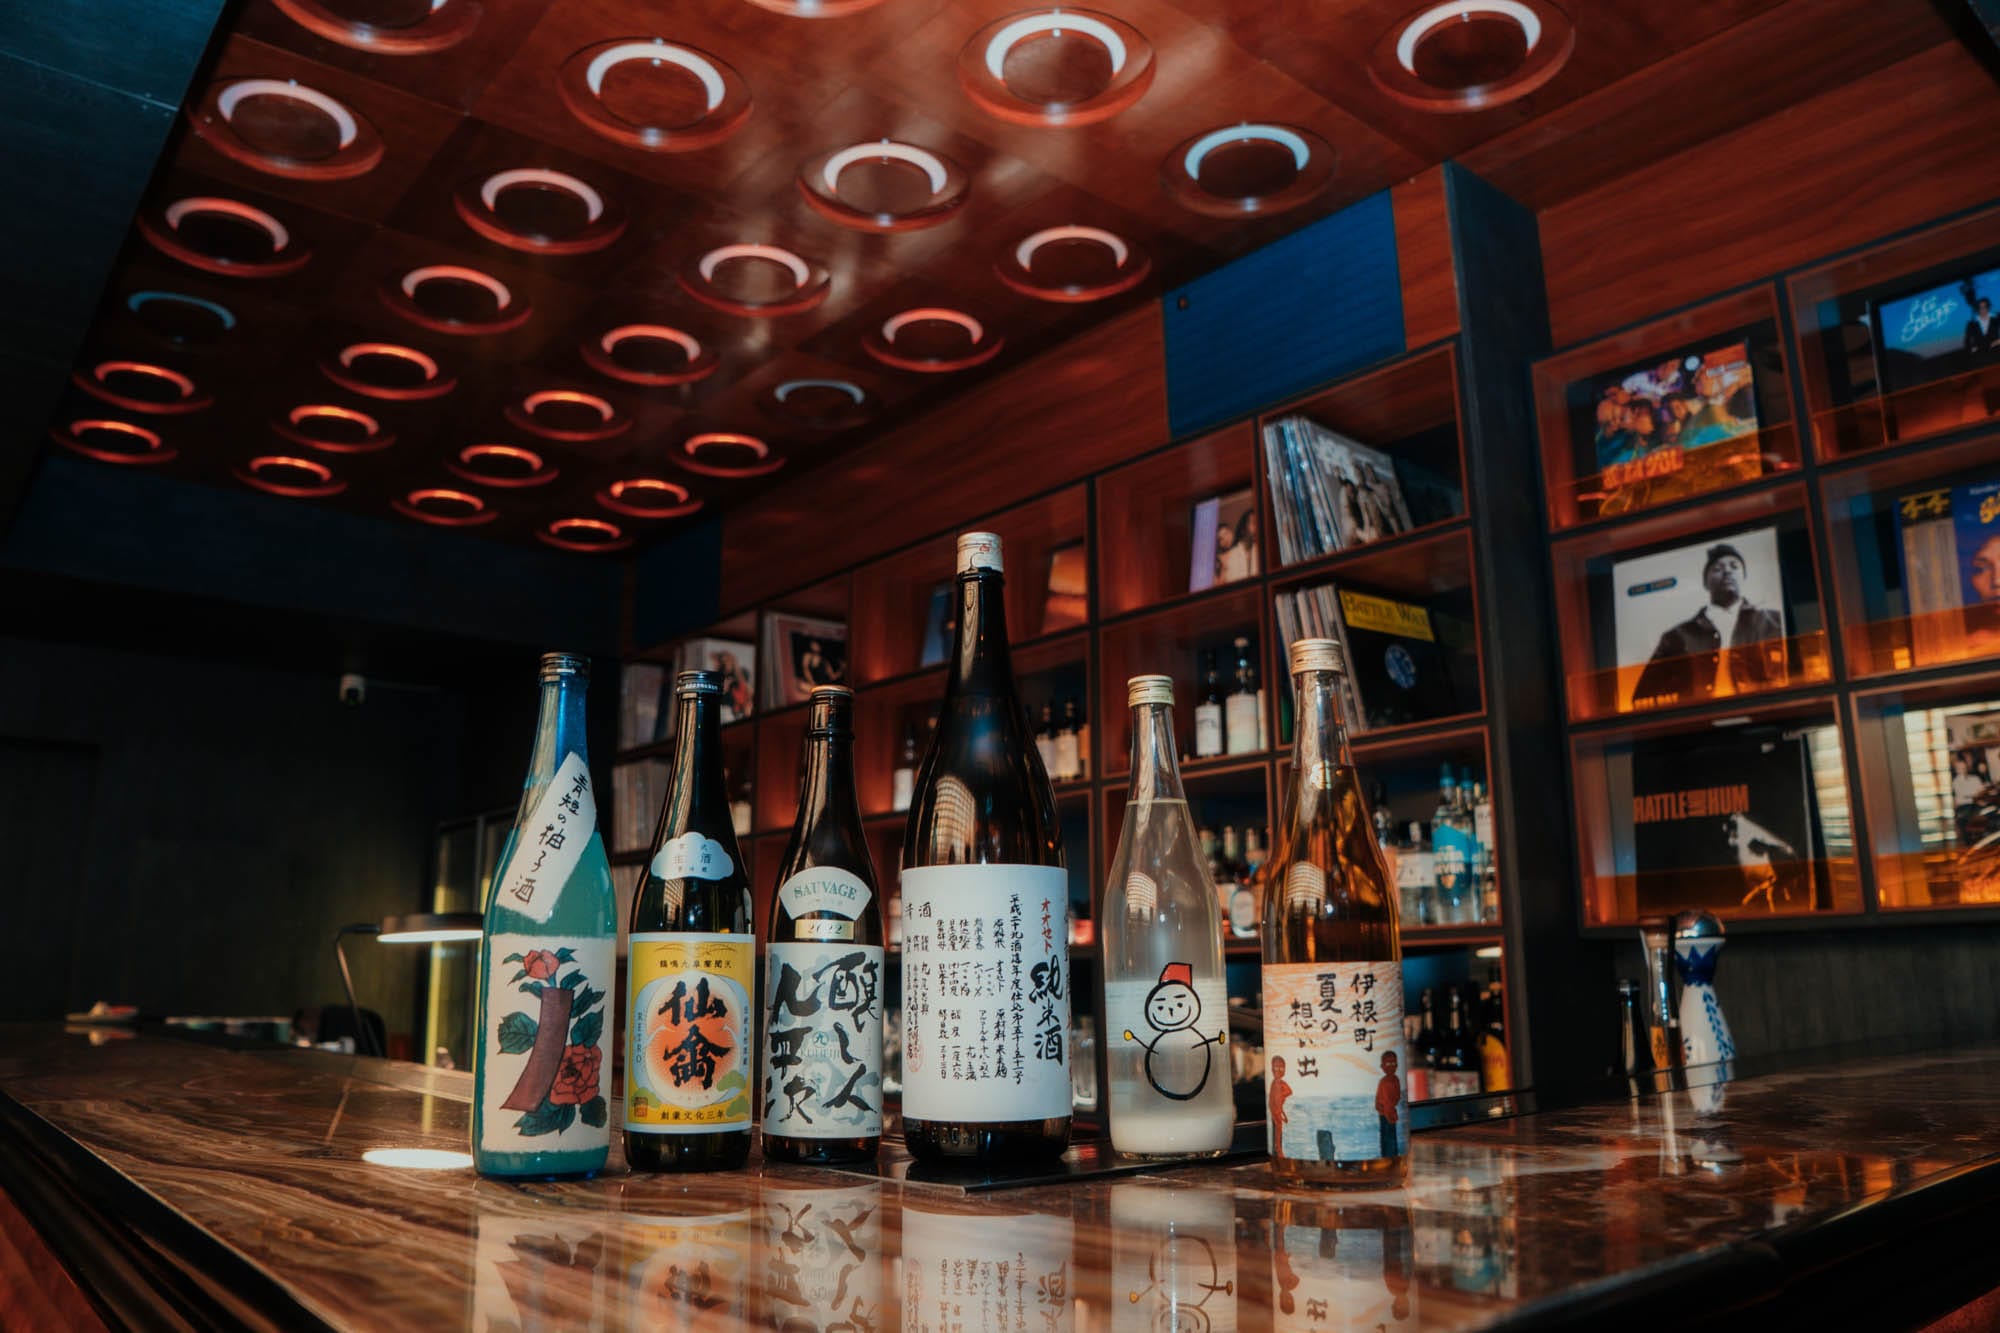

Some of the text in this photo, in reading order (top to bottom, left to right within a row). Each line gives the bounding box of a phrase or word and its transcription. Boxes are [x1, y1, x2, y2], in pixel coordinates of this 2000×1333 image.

[1633, 790, 1688, 824] RATTLE
[1708, 784, 1749, 816] HUM
[793, 881, 857, 901] SAUVAGE
[1041, 898, 1053, 955] オオセト
[1029, 954, 1064, 1068] 純米酒
[1316, 972, 1343, 1035] 夏の
[1350, 972, 1379, 1052] 伊根町
[1288, 998, 1319, 1079] 想い出
